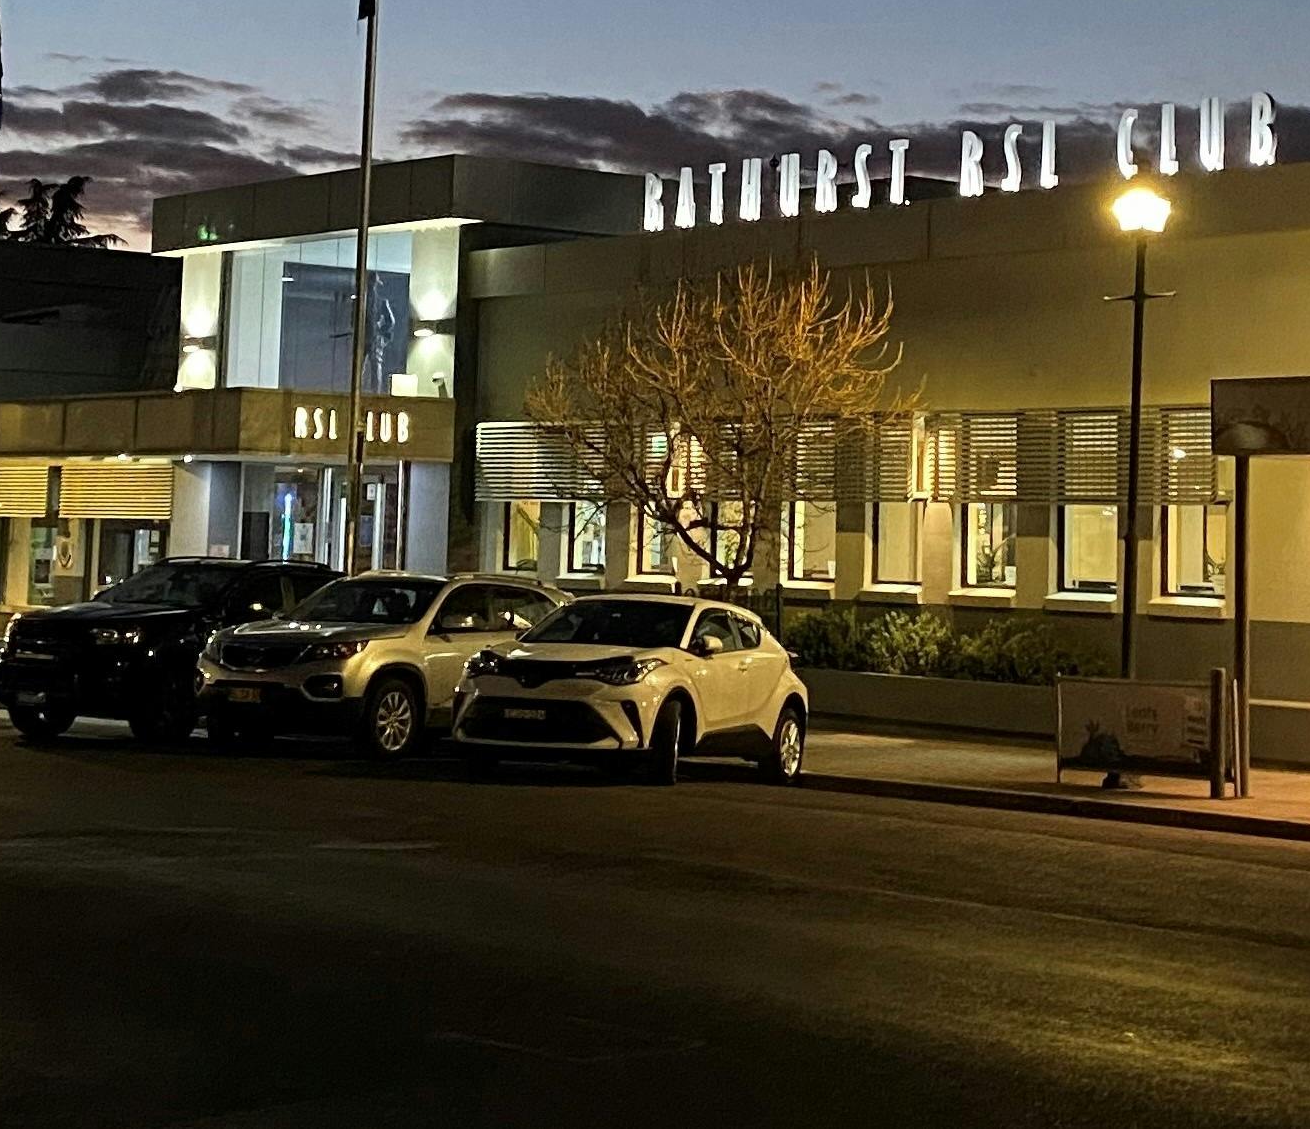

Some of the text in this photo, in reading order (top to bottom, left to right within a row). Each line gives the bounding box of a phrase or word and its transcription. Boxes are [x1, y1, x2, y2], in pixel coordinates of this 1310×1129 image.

[643, 91, 1278, 232] BATHURST RSL CLUB
[294, 406, 409, 443] RSL LUB
